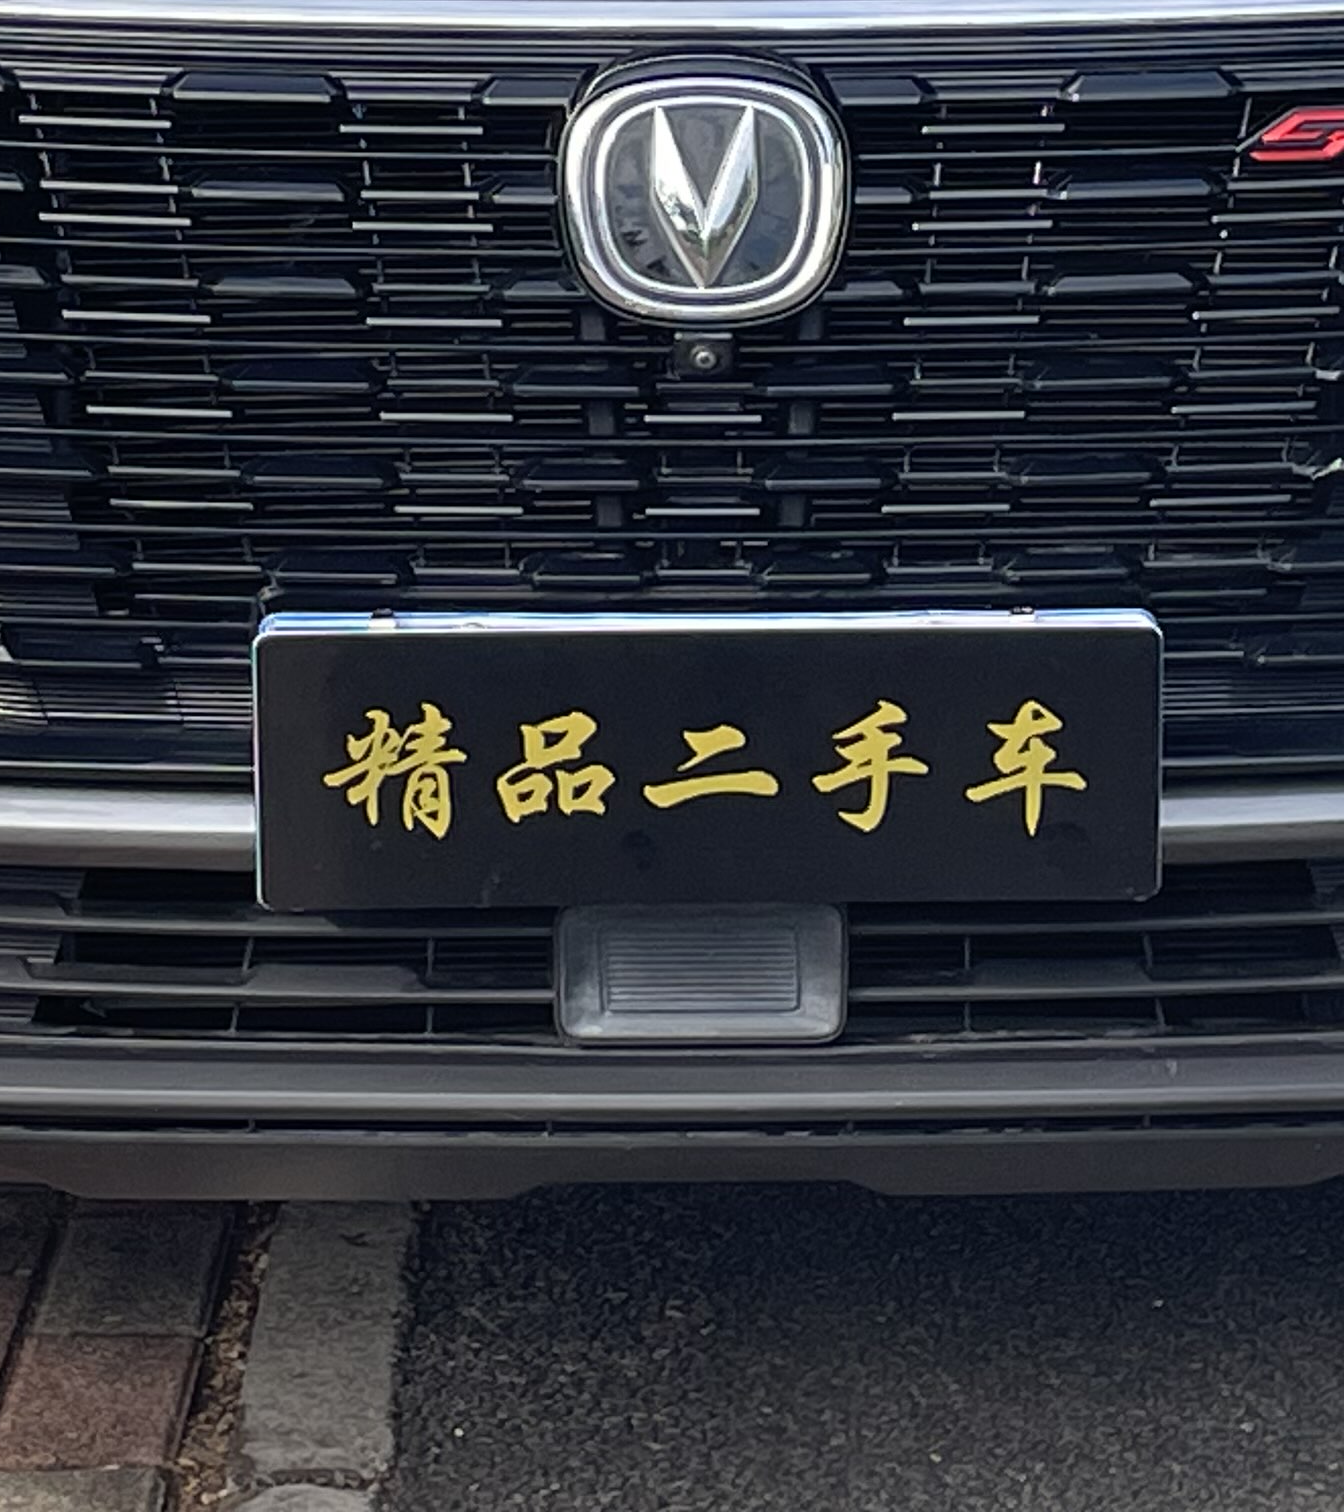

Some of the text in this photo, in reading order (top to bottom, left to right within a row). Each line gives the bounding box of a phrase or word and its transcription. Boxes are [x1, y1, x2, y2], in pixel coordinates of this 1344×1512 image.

[323, 700, 1085, 839] 精品二手车
